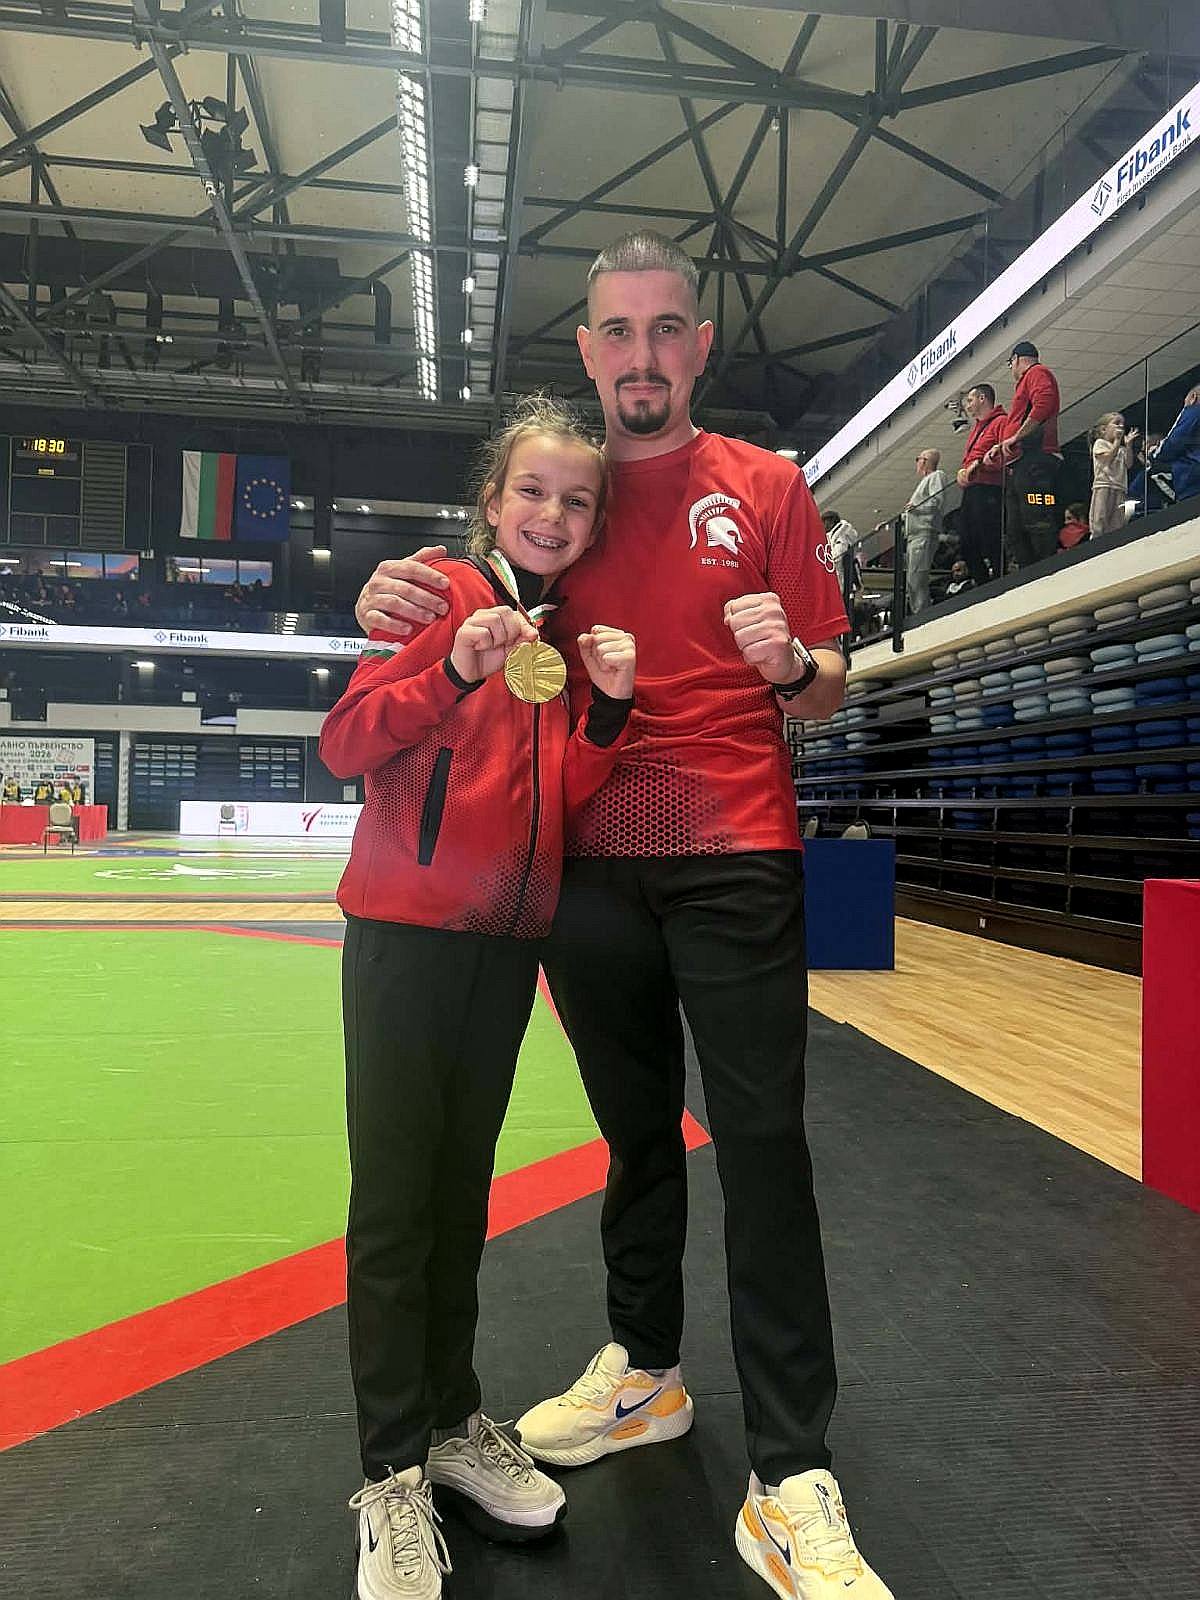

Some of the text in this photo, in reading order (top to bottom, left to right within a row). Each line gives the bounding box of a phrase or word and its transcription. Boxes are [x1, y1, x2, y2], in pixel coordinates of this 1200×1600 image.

[1117, 107, 1191, 193] Fibank
[1117, 188, 1132, 206] First
[920, 328, 957, 376] Fibank
[701, 557, 719, 566] EST.
[10, 626, 49, 637] Fibank
[169, 632, 208, 643] Fibank
